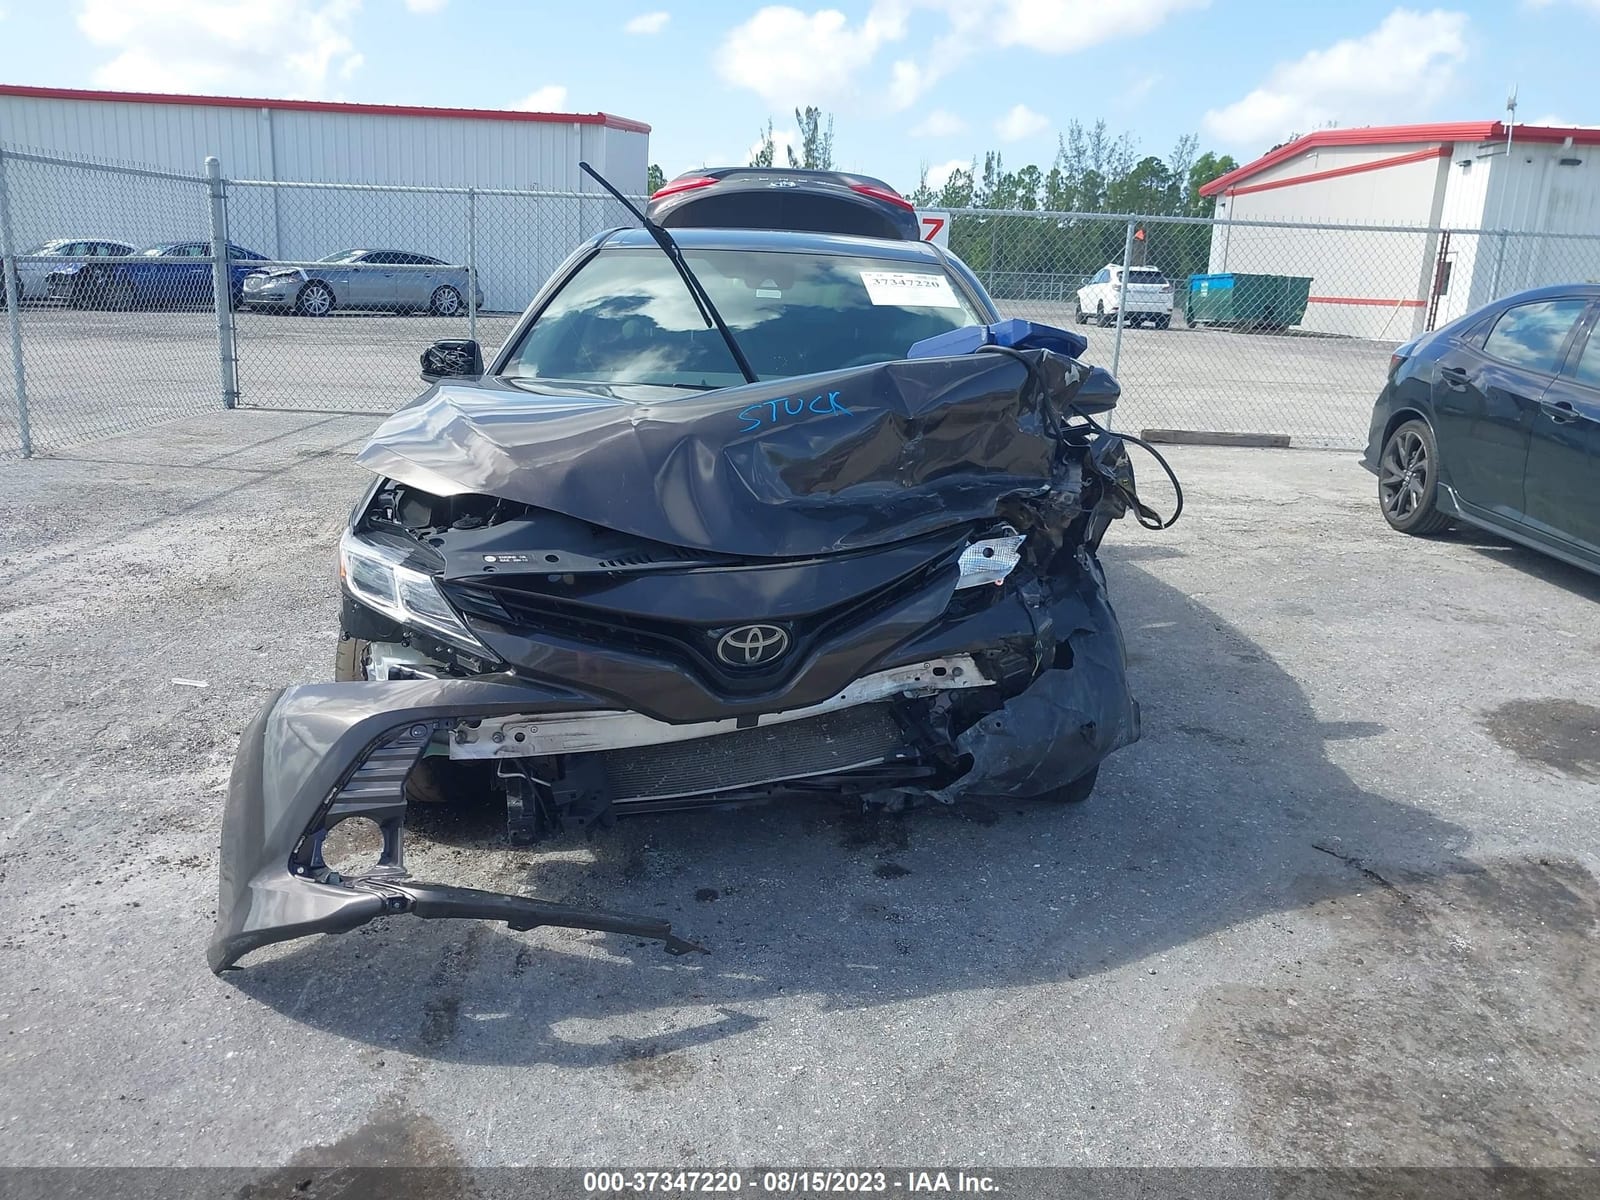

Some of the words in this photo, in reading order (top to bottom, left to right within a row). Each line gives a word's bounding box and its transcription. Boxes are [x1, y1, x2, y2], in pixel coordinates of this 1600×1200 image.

[922, 218, 944, 241] 7
[872, 278, 940, 288] 37347220
[738, 391, 853, 432] STUCK
